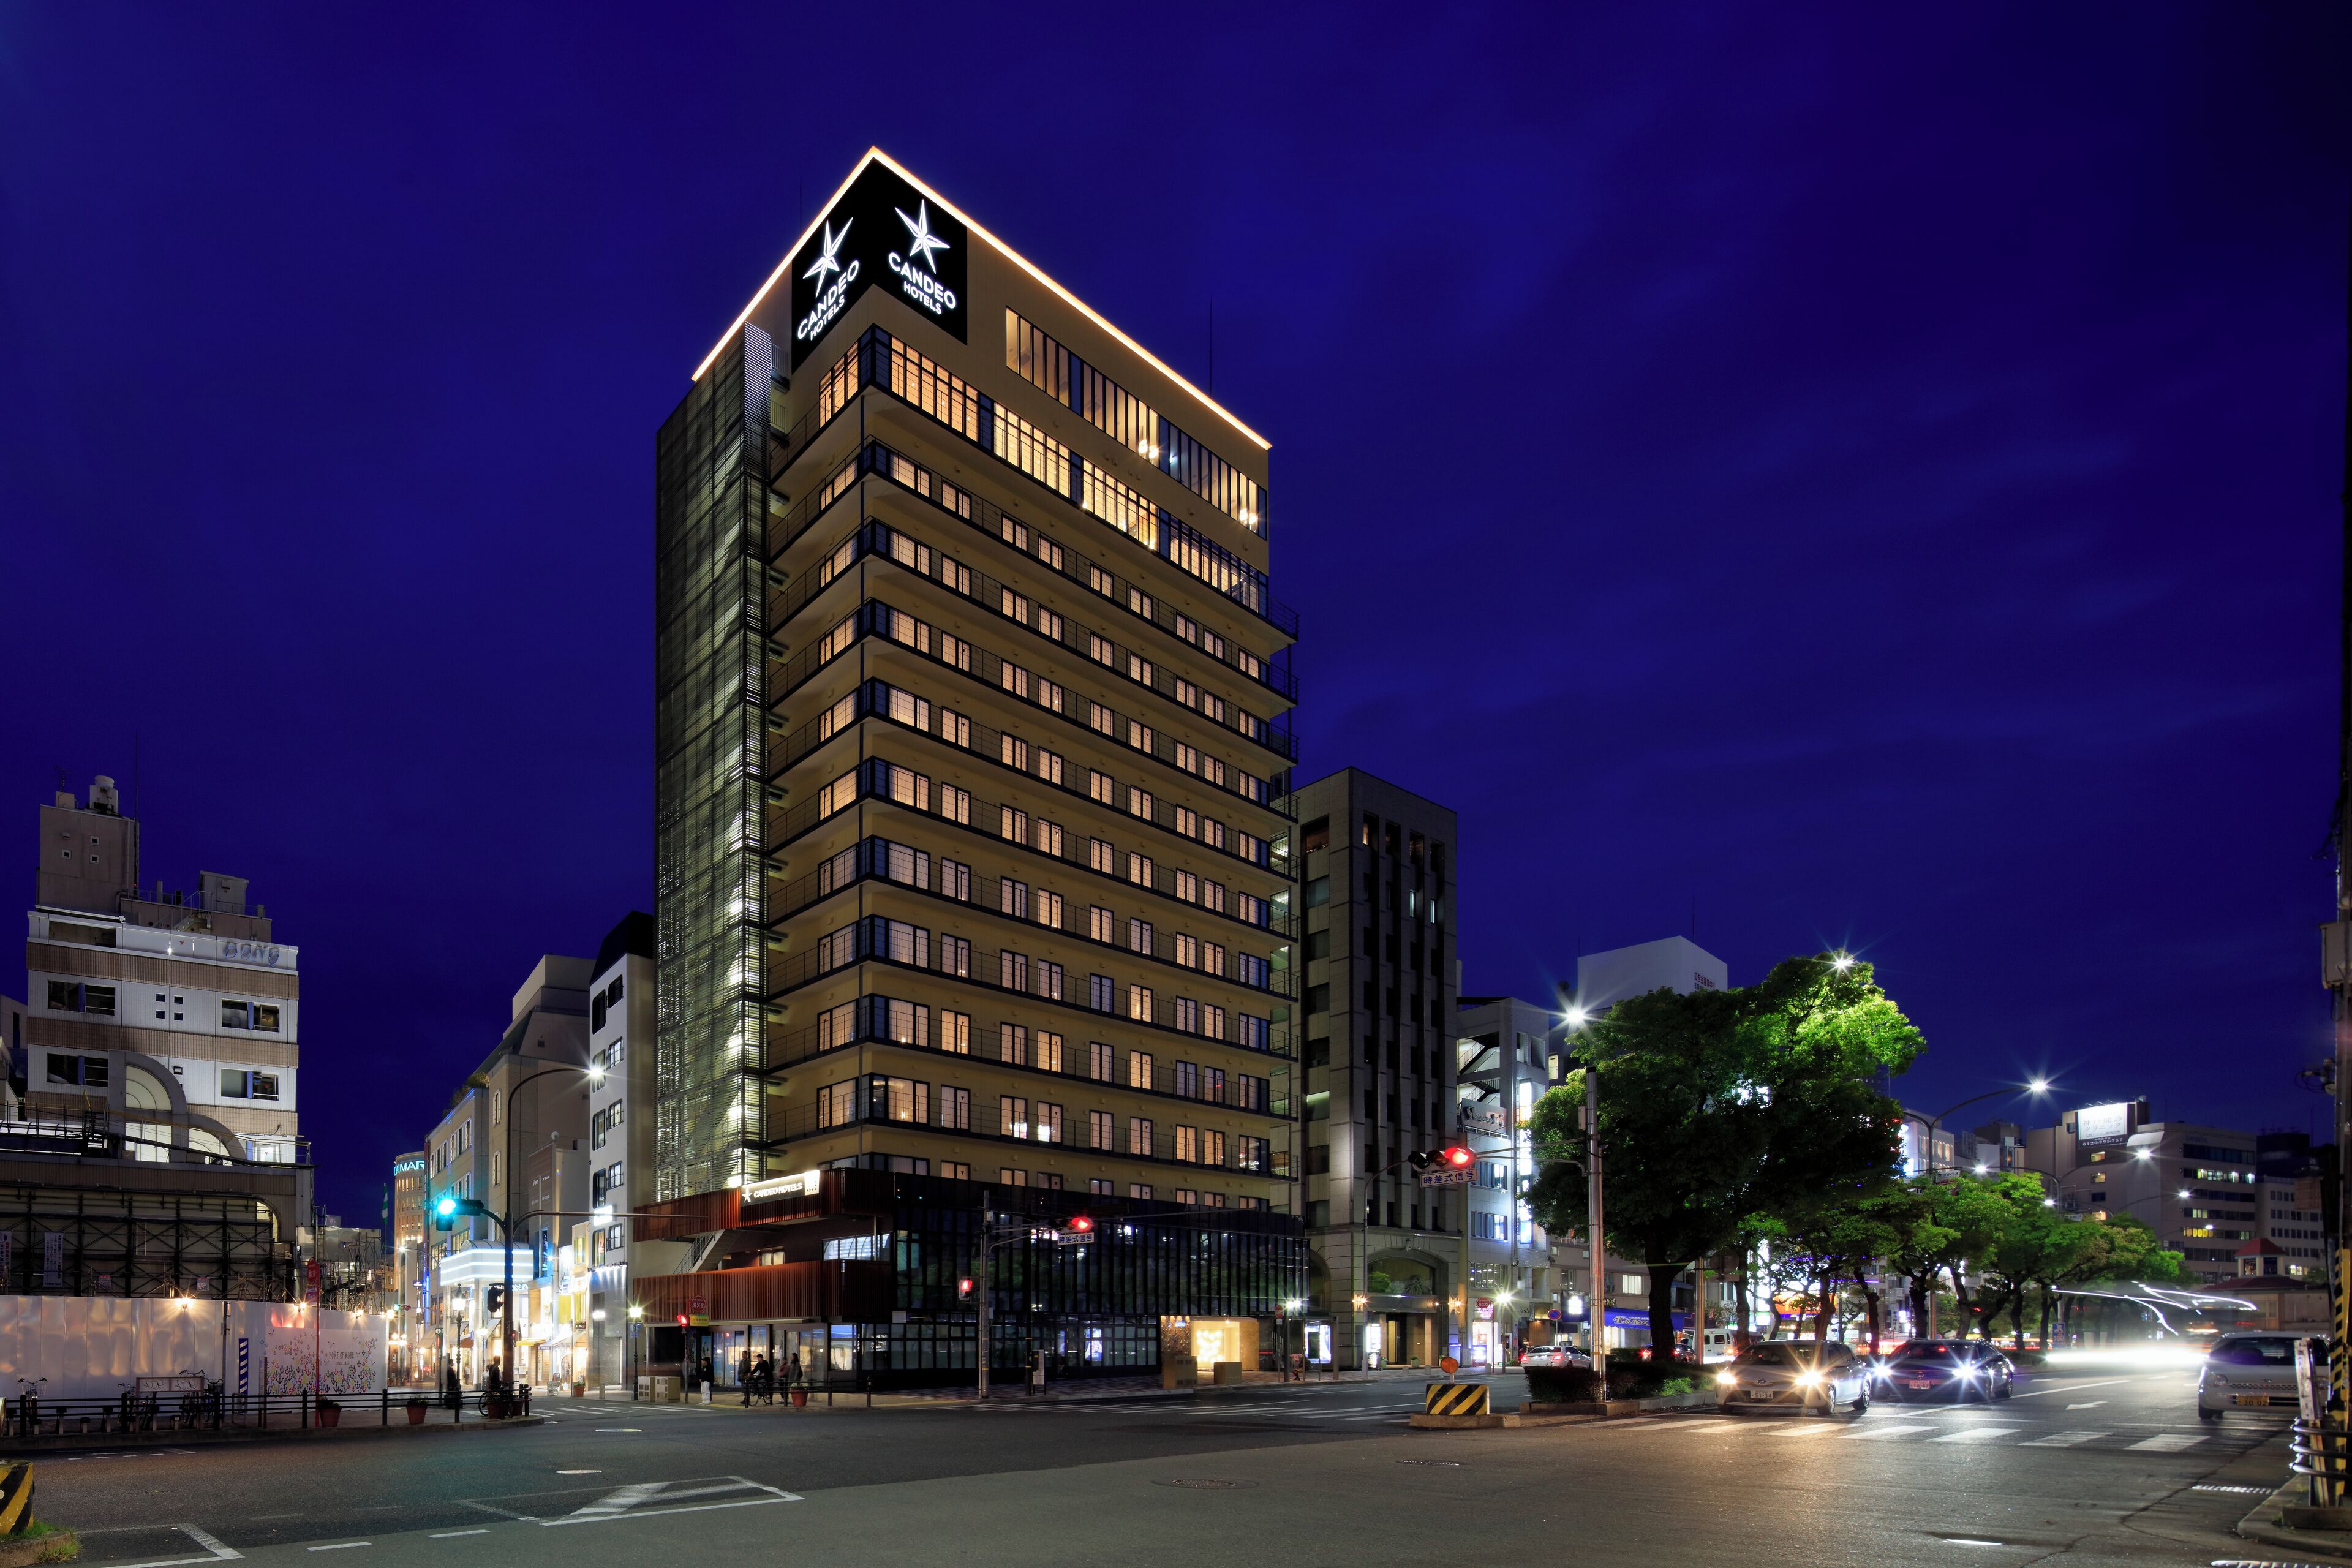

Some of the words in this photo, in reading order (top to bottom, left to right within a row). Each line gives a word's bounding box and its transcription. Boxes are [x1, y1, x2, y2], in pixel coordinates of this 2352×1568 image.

[889, 252, 956, 309] CANDEO
[797, 260, 859, 339] CANDEO
[903, 281, 942, 314] HOTELS
[810, 295, 845, 340] HOTELS
[2086, 1123, 2121, 1131] クリニック
[1423, 1170, 1474, 1184] 時差式信号
[753, 1186, 778, 1198] CANDEO
[778, 1182, 803, 1194] HOTELS
[1058, 1234, 1092, 1244] 時差式信号
